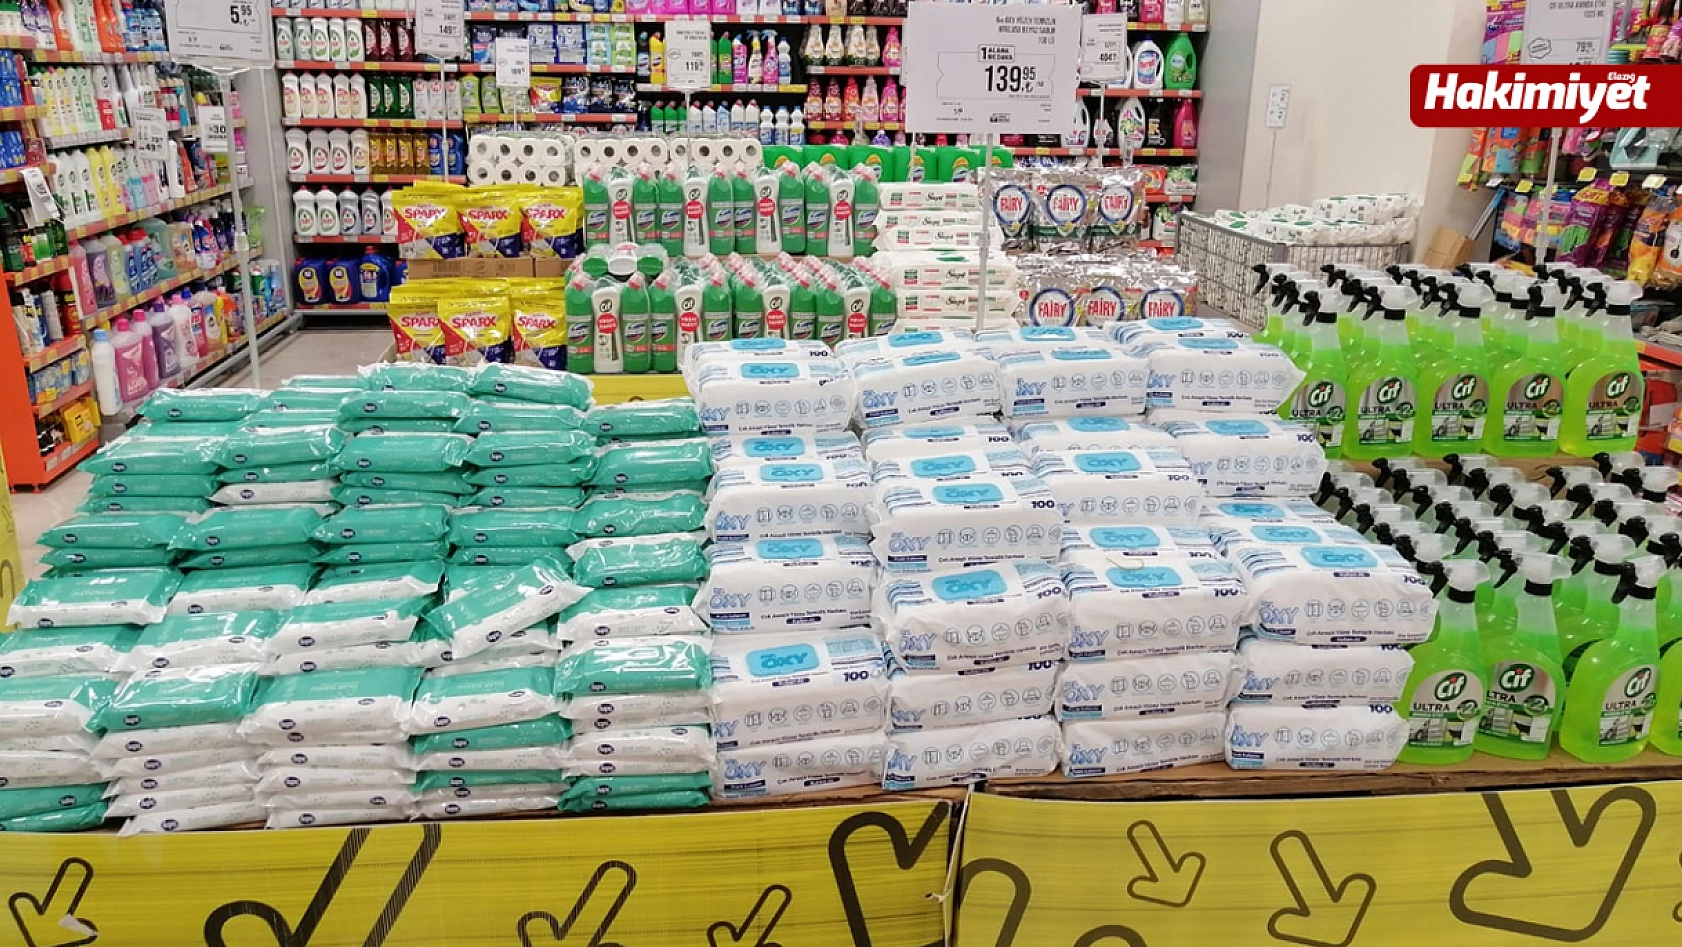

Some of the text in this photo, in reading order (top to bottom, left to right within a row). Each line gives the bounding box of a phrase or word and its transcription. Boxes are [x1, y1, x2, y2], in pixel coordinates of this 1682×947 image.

[981, 46, 987, 60] 1
[984, 64, 1036, 92] 139 95
[1000, 195, 1024, 212] FAIRY
[468, 209, 508, 220] SPARX
[1038, 301, 1067, 318] FAIRY
[1087, 300, 1117, 317] FAIRY
[1148, 301, 1176, 318] FAIRY
[452, 315, 497, 328] SPARX
[518, 315, 556, 329] SPARX
[1379, 380, 1401, 401] Cif
[1454, 377, 1475, 399] Cif
[1526, 376, 1550, 398] Cif
[1607, 375, 1629, 396] Cif
[1310, 384, 1332, 404] Cif
[1292, 409, 1322, 417] ULTRA
[1361, 406, 1390, 414] ULTRA
[1435, 402, 1465, 410] ULTRA
[1507, 402, 1537, 410] ULTRA
[1296, 434, 1316, 443] 100
[1031, 500, 1055, 509] 100
[889, 536, 931, 552] OXY
[1402, 574, 1426, 585] 100
[1036, 586, 1062, 600] 100
[1213, 588, 1239, 597] 100
[1260, 607, 1299, 625] OXY
[843, 670, 870, 682] 100
[1502, 667, 1533, 689] Cif
[1436, 675, 1466, 699] Cif
[1626, 670, 1650, 697] Cif
[1486, 690, 1516, 703] LTRA
[1369, 704, 1393, 714] 100
[1413, 702, 1450, 712] ULTRA
